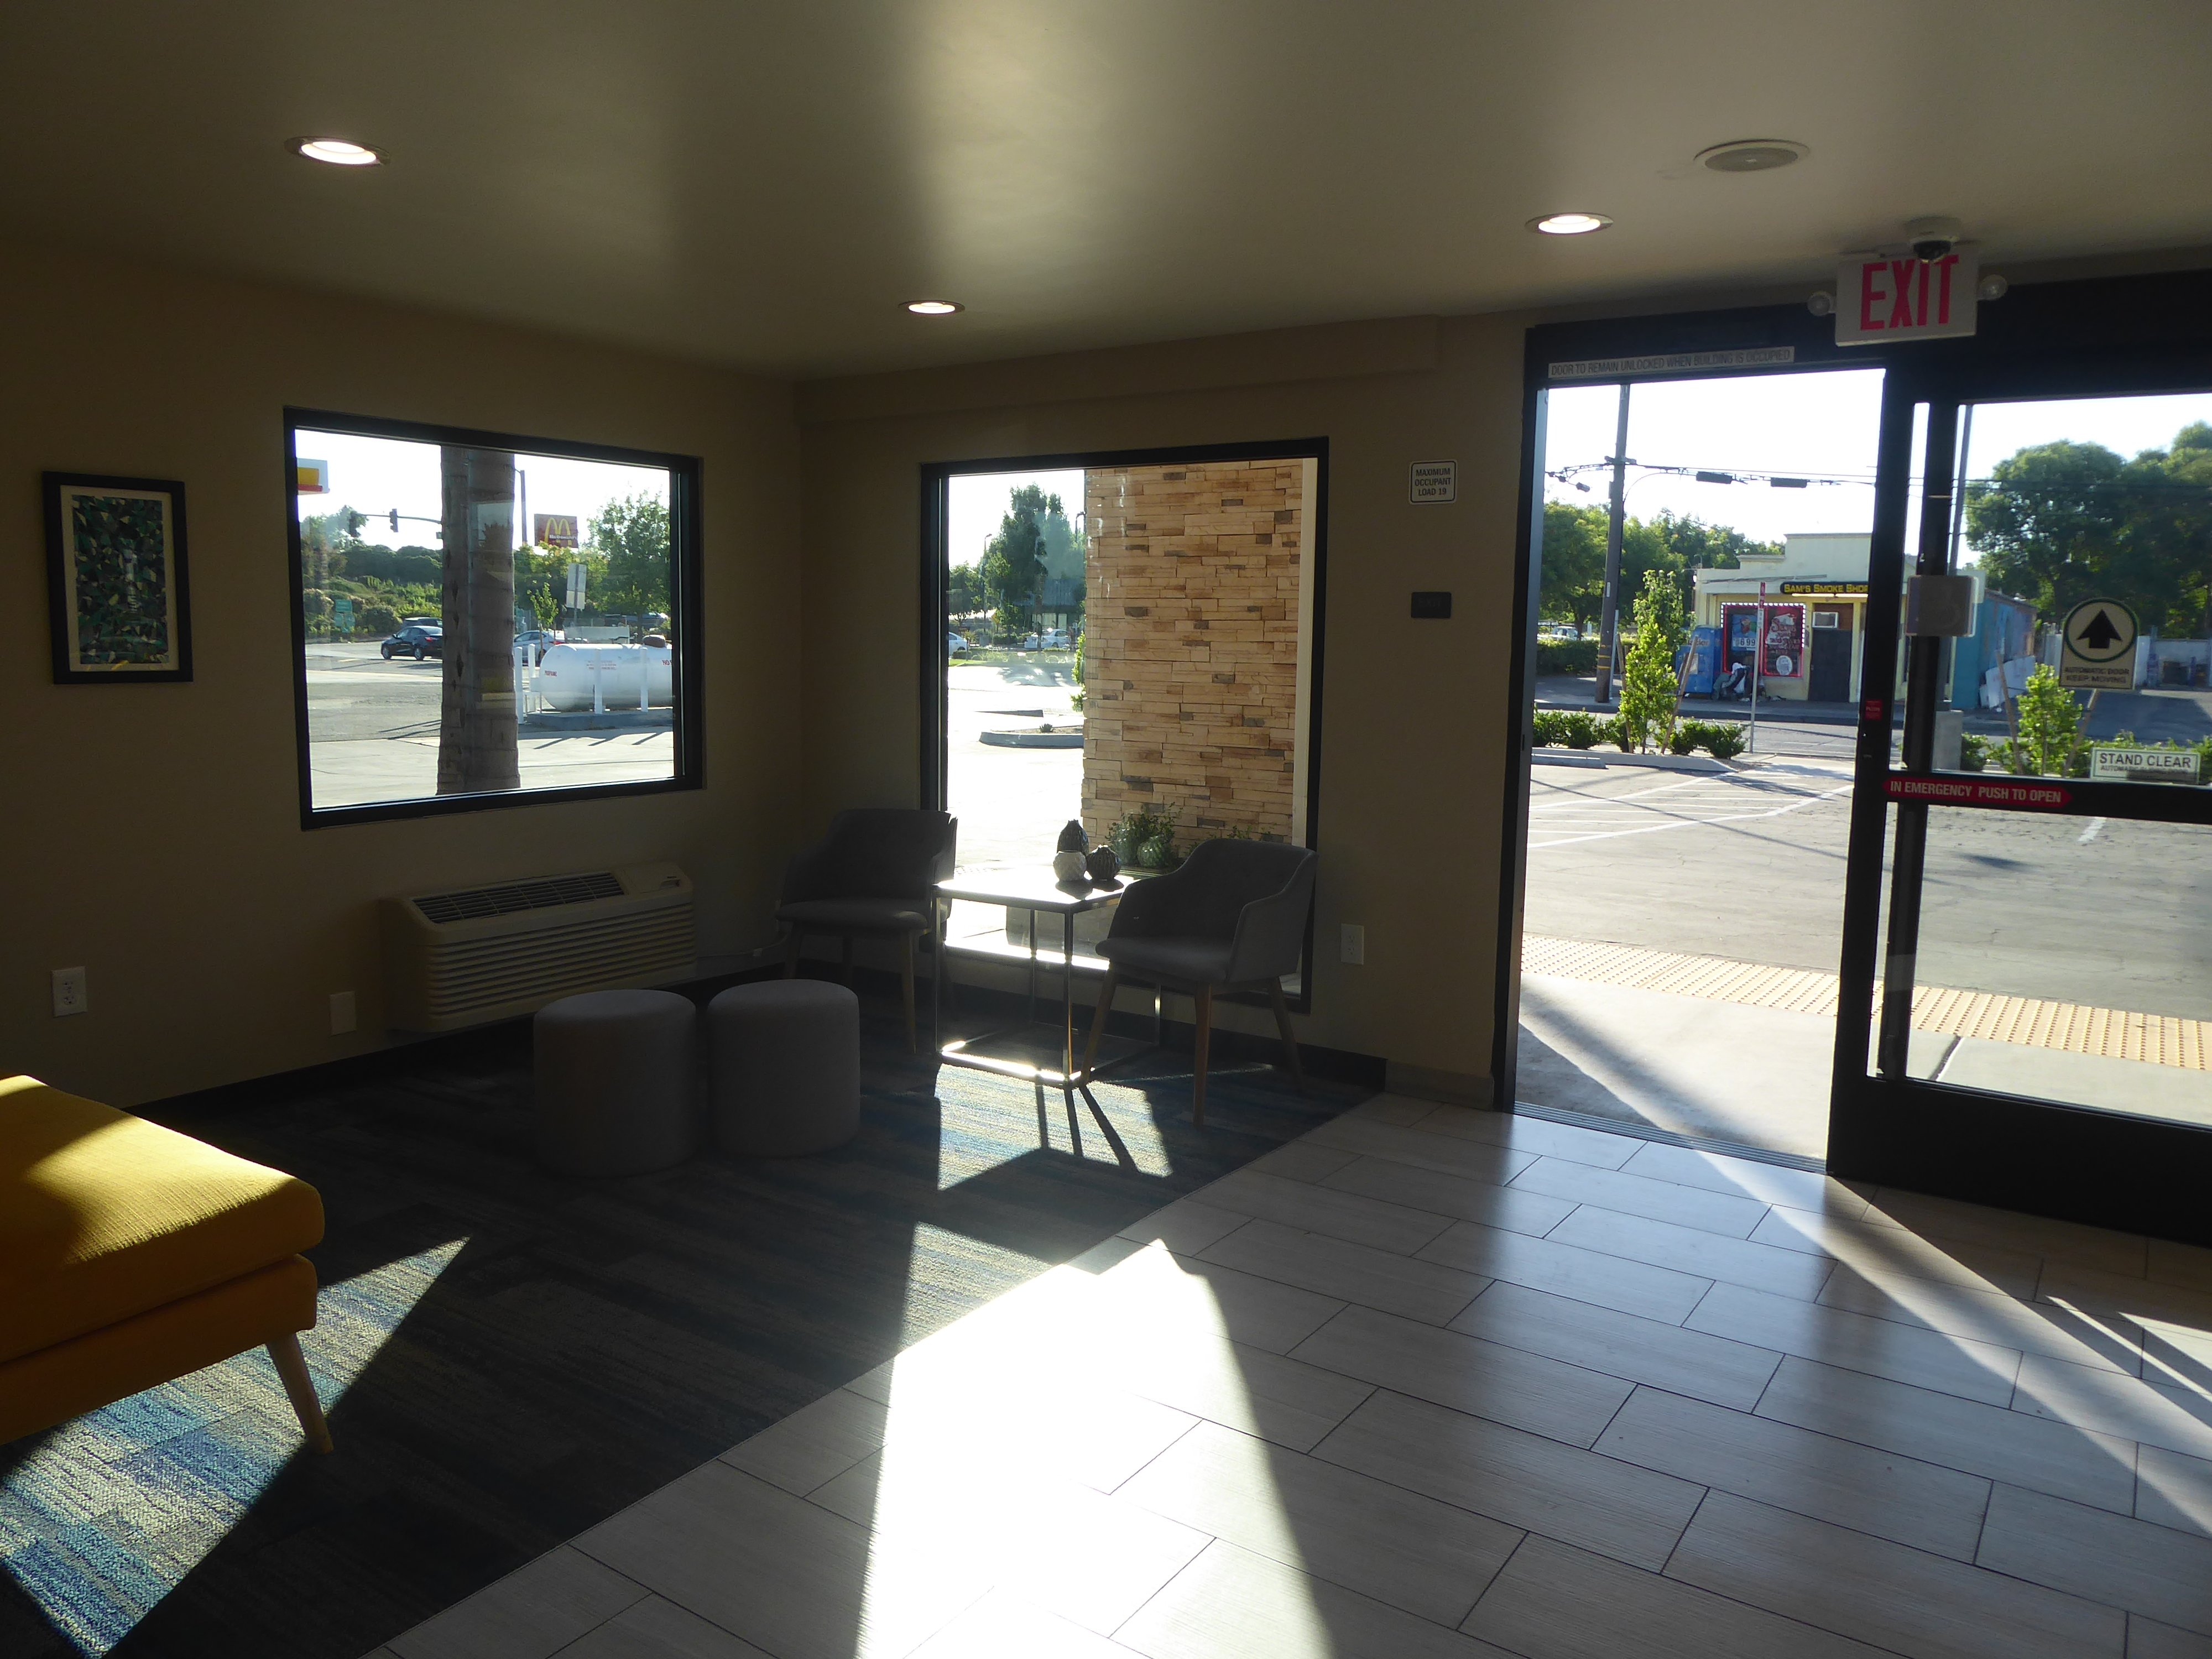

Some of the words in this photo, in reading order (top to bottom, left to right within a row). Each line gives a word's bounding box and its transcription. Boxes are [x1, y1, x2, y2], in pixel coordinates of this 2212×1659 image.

[1861, 254, 1959, 331] EXIT
[1551, 364, 1573, 375] DOOR
[1575, 364, 1586, 374] TO
[1588, 361, 1618, 373] REMAIN
[1621, 358, 1664, 371] UNLOCKED
[1666, 355, 1691, 367] WHEN
[1694, 352, 1733, 366] BUILDING
[1746, 349, 1790, 362] OCCUPIED
[1416, 468, 1451, 477] MAXIMUM
[1415, 478, 1451, 486] OCCUPANT
[1418, 488, 1436, 496] LOAD
[1438, 487, 1447, 495] 19
[1784, 584, 1811, 592] SAM'S
[1813, 584, 1844, 592] SMOKE
[2100, 753, 2143, 765] STAND
[2147, 755, 2191, 768] CLEAR
[1890, 781, 1901, 792] IN
[1905, 782, 1973, 797] EMERGENCY
[1978, 786, 2009, 800] PUSH
[2012, 789, 2026, 800] TO
[2030, 790, 2062, 802] OPEN
